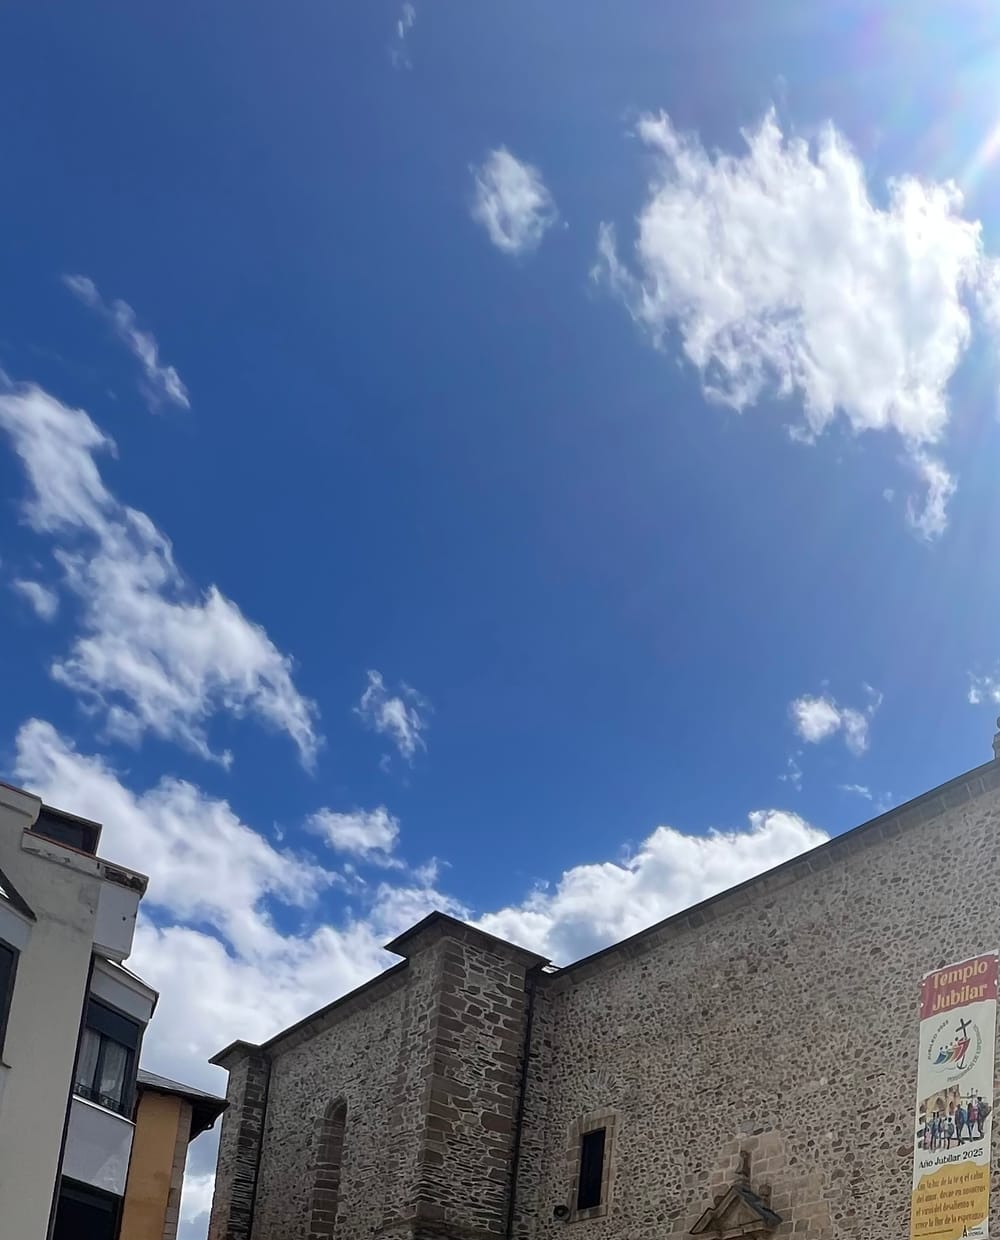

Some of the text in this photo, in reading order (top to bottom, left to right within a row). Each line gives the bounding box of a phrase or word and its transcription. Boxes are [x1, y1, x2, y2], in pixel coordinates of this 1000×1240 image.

[932, 960, 988, 989] Templo
[932, 984, 988, 1011] Jubilar
[919, 1147, 984, 1169] Año Jubilar 2025
